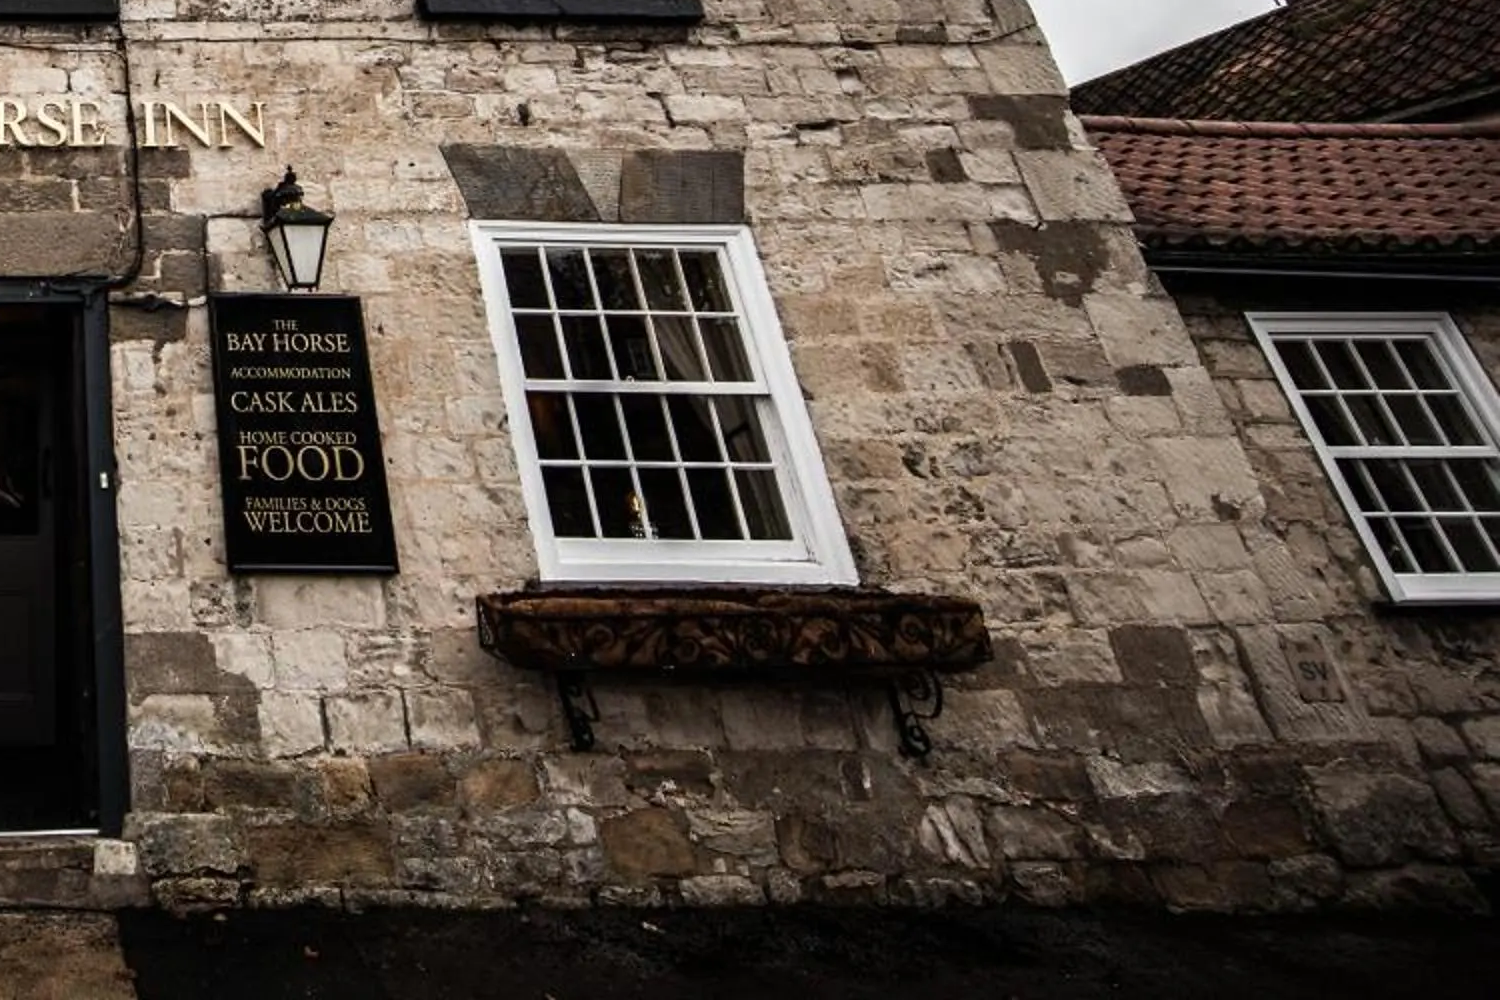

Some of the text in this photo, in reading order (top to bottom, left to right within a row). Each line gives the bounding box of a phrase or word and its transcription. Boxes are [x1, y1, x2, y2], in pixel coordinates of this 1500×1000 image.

[141, 99, 268, 149] INN
[274, 320, 299, 331] THE
[227, 333, 351, 353] BAY HORSE
[230, 367, 351, 380] ACCOMMODATION
[231, 391, 358, 413] CASK ALES
[239, 431, 357, 445] HOME COOKED
[237, 445, 364, 481] FOOD
[245, 497, 366, 511] FAMILIES & DOGS
[244, 511, 372, 533] WELCOME
[1298, 661, 1327, 680] SV
